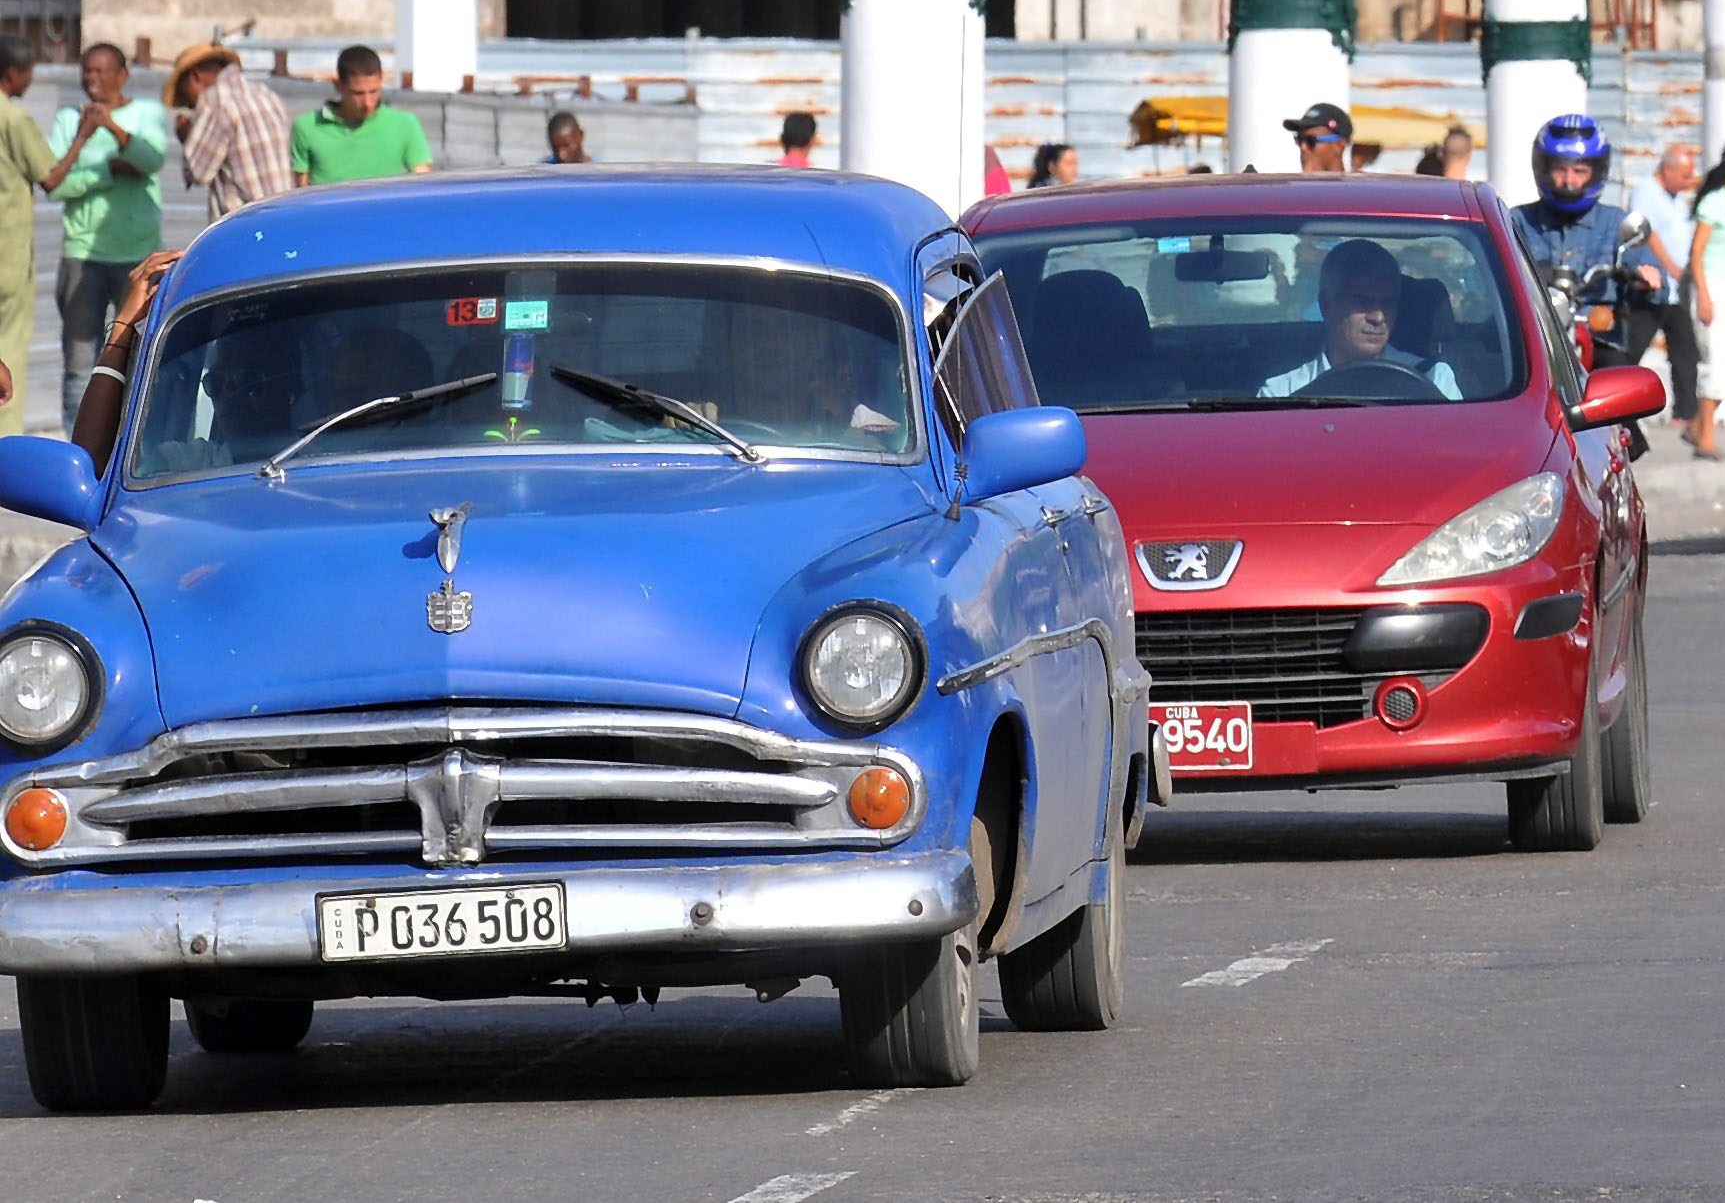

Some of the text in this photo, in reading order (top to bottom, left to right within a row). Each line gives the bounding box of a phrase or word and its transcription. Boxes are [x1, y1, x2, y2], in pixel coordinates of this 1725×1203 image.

[449, 300, 477, 323] 13
[1165, 706, 1199, 719] CUBA
[1149, 717, 1248, 753] 9540
[333, 907, 344, 950] CUBA
